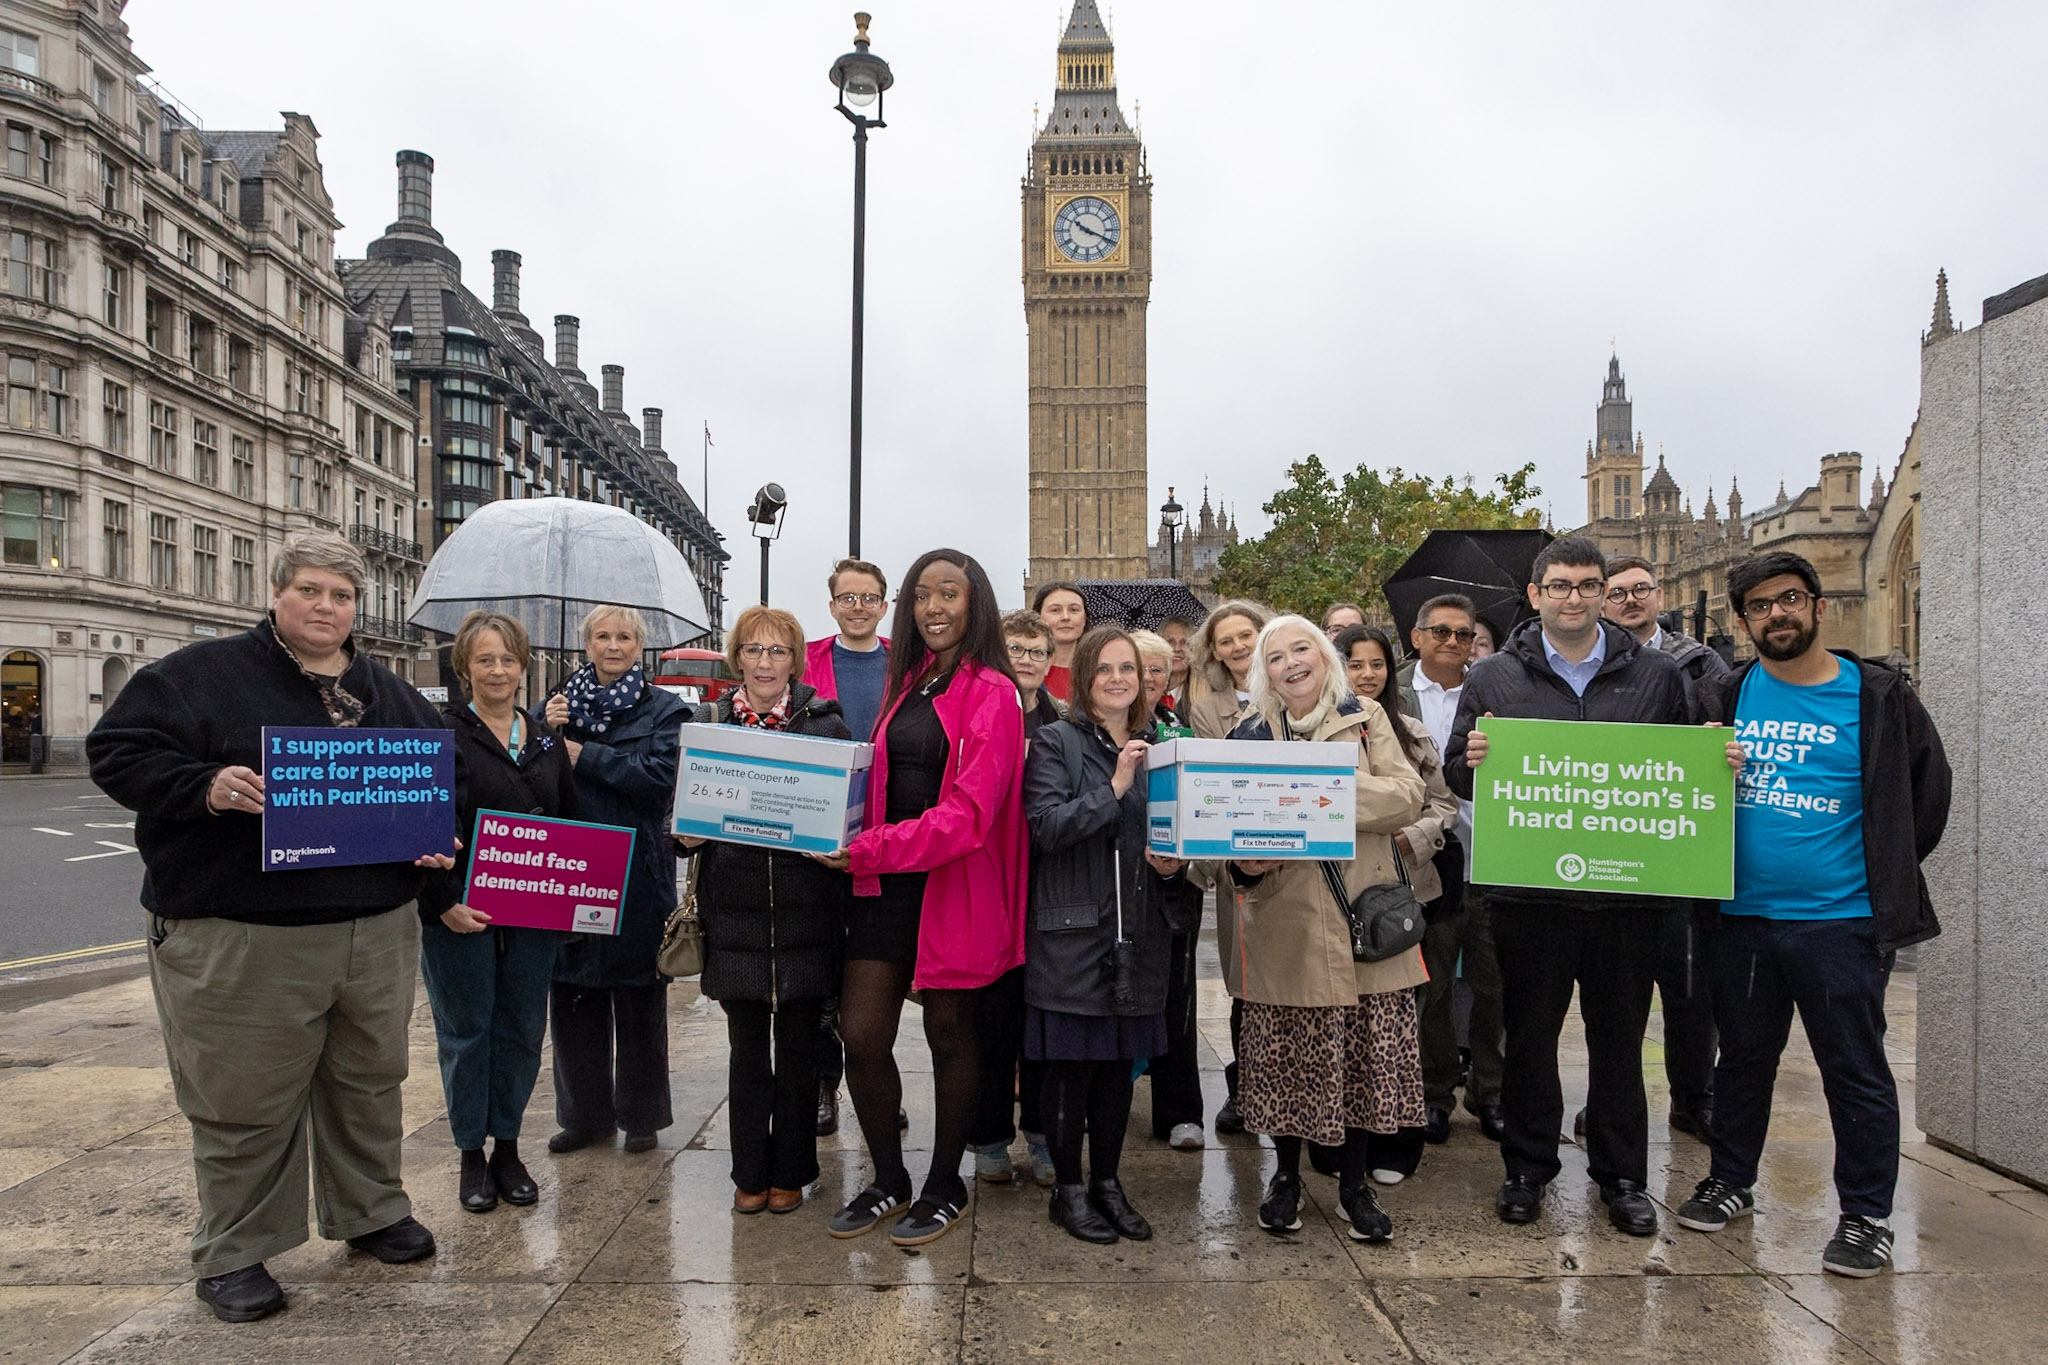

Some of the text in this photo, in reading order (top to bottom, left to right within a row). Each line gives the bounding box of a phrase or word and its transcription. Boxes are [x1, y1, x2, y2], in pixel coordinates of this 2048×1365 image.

[1163, 729, 1180, 737] tide
[1734, 719, 1837, 744] CARERS
[272, 738, 442, 760] I support better
[1738, 740, 1812, 764] RUST
[271, 762, 433, 784] care for people
[690, 762, 800, 785] Dear Yvette Cooper MP
[1523, 754, 1685, 783] Living with
[1740, 774, 1788, 790] KE A
[271, 787, 323, 807] with
[750, 804, 767, 812] (CHC)
[764, 800, 794, 809] continuing
[795, 803, 826, 812] healthcare
[1692, 787, 1716, 811] is
[1736, 787, 1841, 814] FFERENCE
[482, 820, 548, 842] No one
[756, 828, 782, 838] funding
[1508, 806, 1697, 840] hard enough
[1268, 840, 1296, 848] funding
[478, 847, 588, 872] should face
[1588, 858, 1644, 868] Huntington's
[1588, 866, 1622, 874] Disease
[474, 873, 619, 900] dementia alone
[1588, 873, 1638, 882] Association
